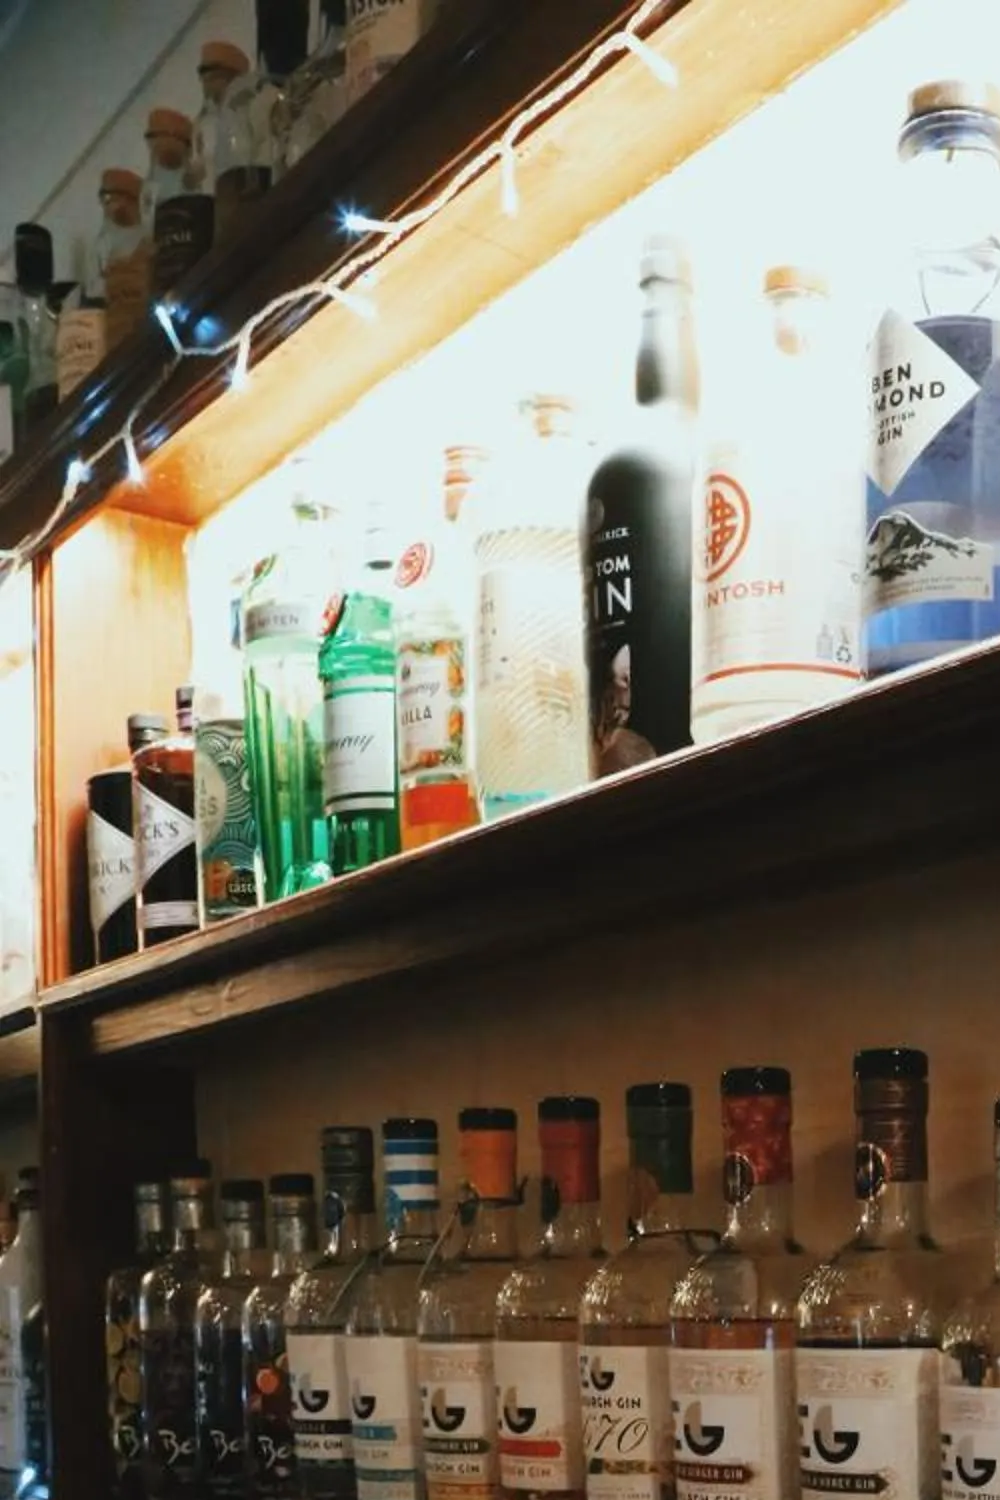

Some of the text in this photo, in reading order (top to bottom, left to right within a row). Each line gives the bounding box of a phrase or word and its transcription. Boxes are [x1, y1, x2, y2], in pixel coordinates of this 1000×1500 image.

[872, 362, 911, 394] BEN
[878, 424, 903, 446] GIN
[596, 554, 631, 577] TOM
